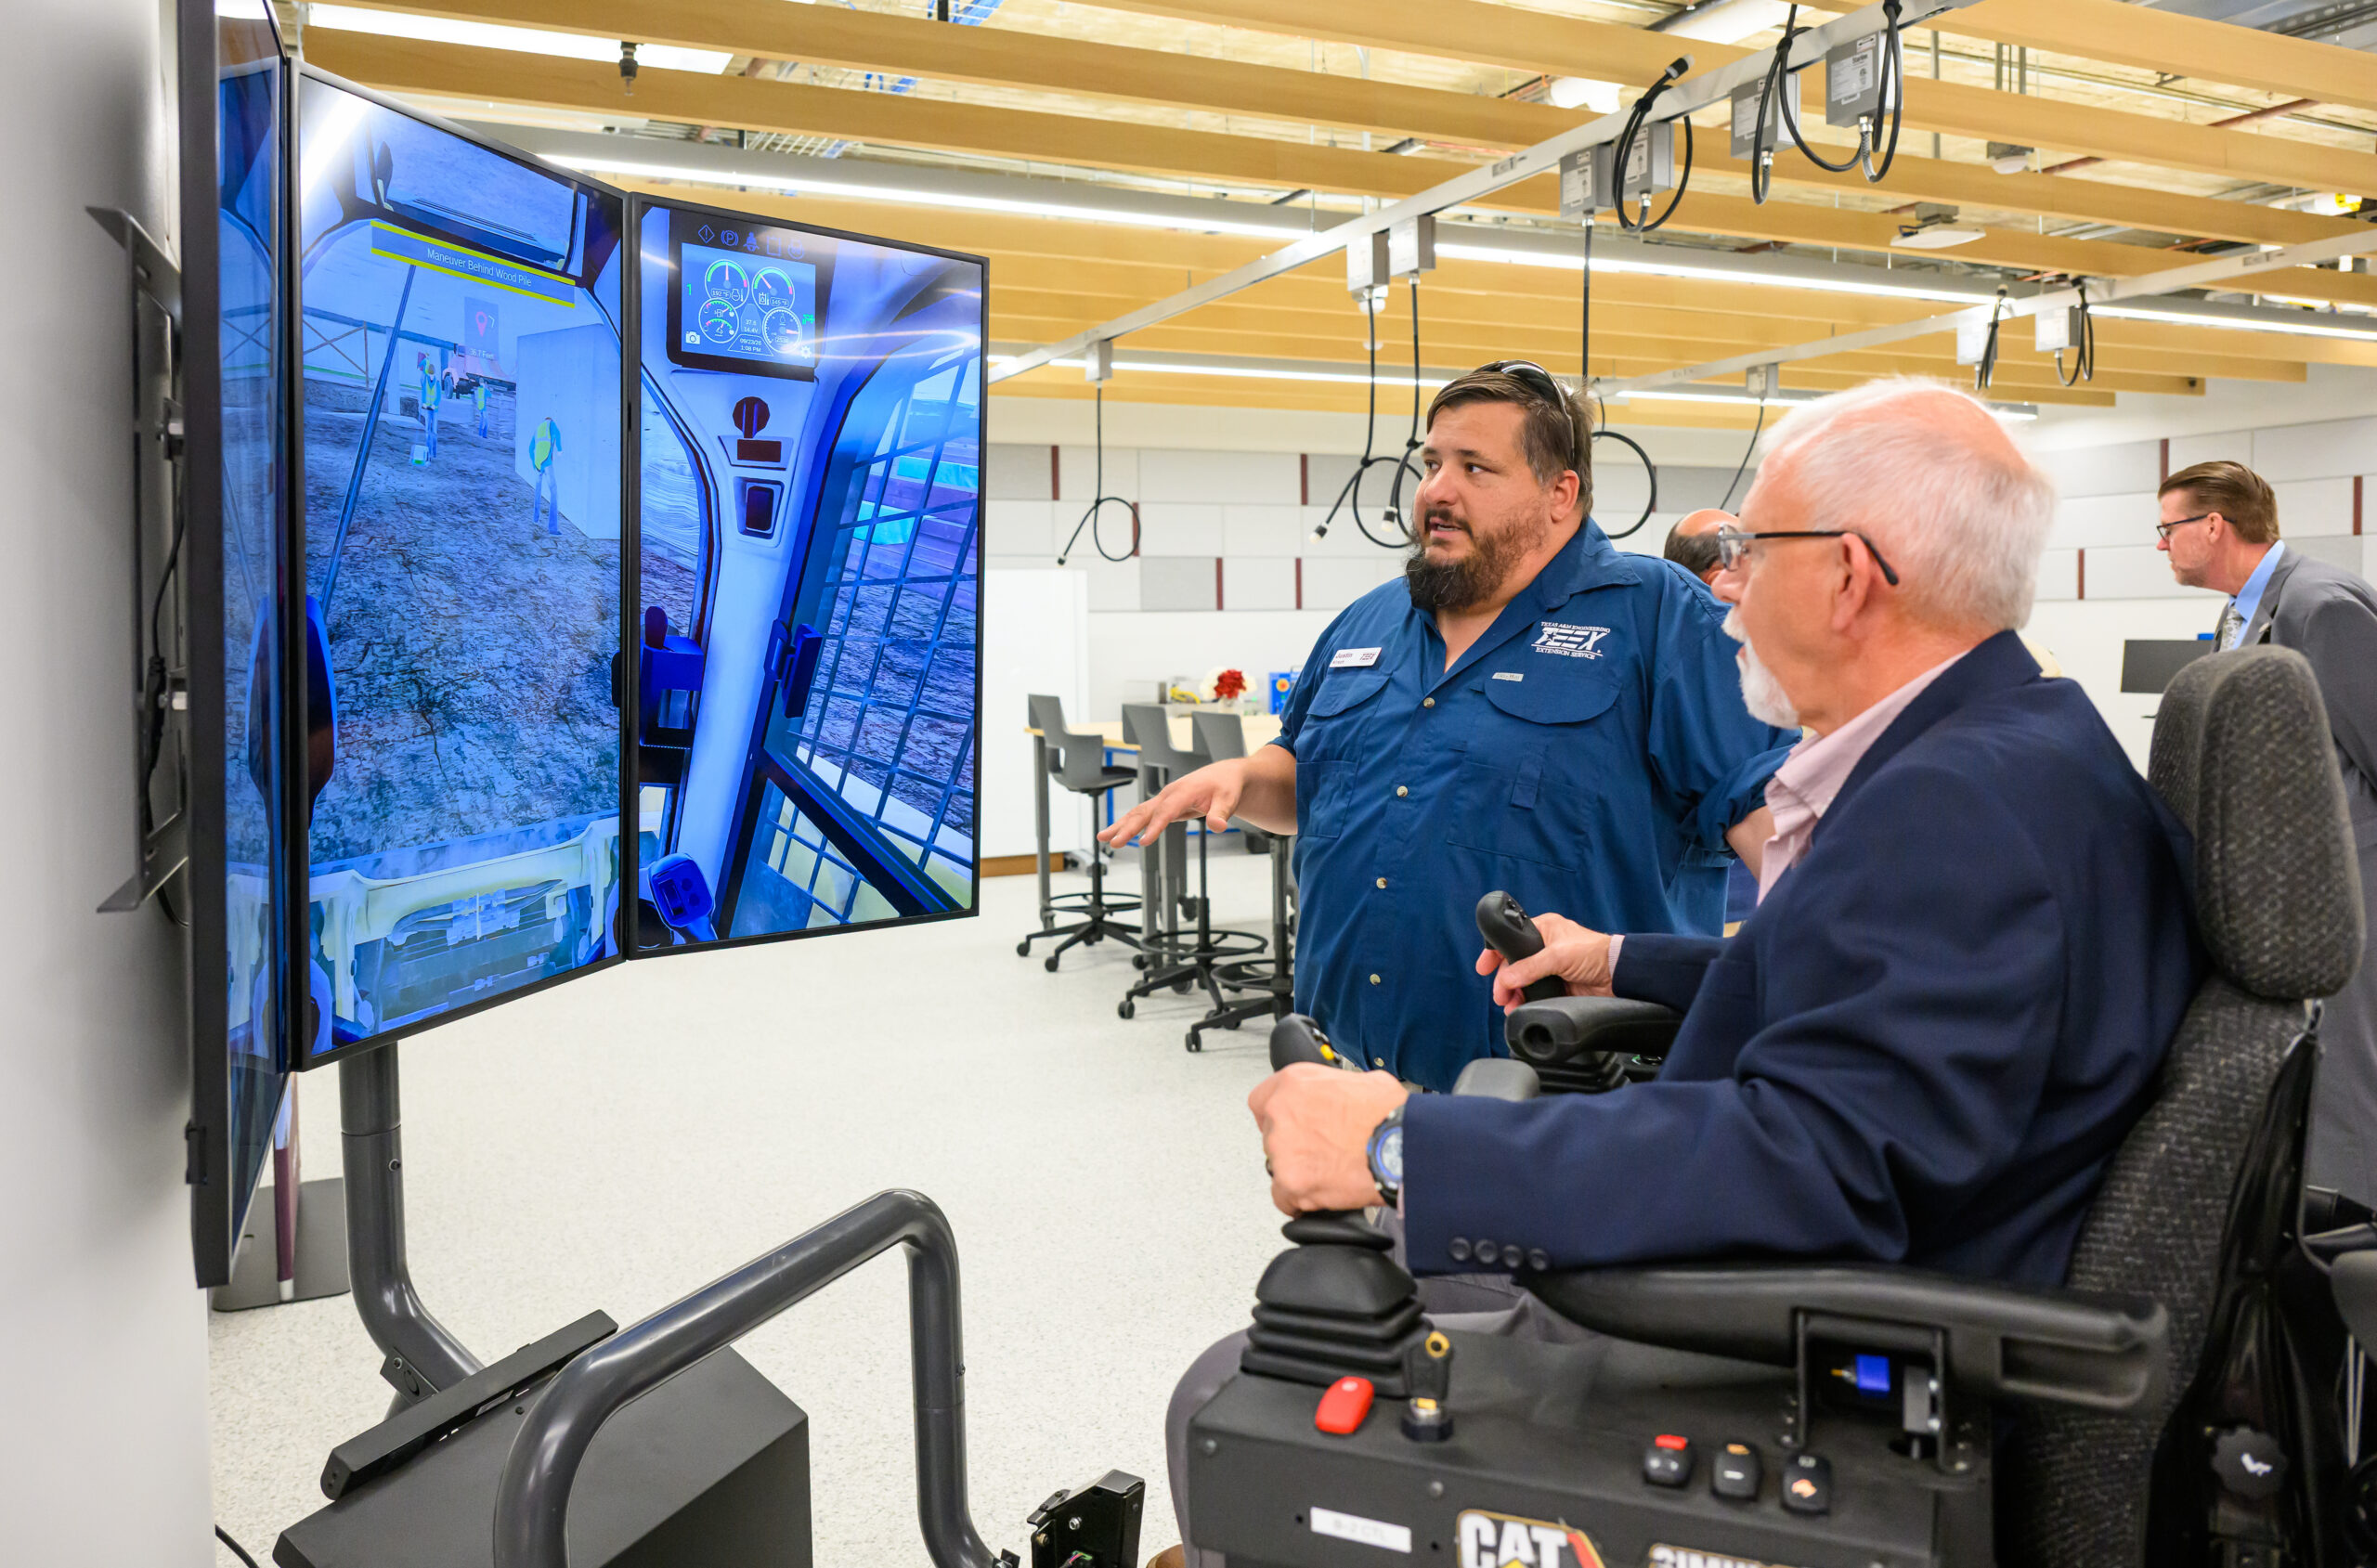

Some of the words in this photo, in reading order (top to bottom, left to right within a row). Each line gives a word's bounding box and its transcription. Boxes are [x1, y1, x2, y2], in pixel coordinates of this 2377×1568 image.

[427, 248, 466, 268] Maneuver
[468, 260, 493, 277] Behind
[496, 267, 516, 282] Wood
[518, 275, 531, 287] Pile
[1534, 627, 1608, 651] TEEX
[1571, 625, 1611, 633] ENGINEERING
[1536, 646, 1569, 656] EXTENSION
[1570, 651, 1595, 660] SERVICE
[1460, 1512, 1567, 1568] CAT
